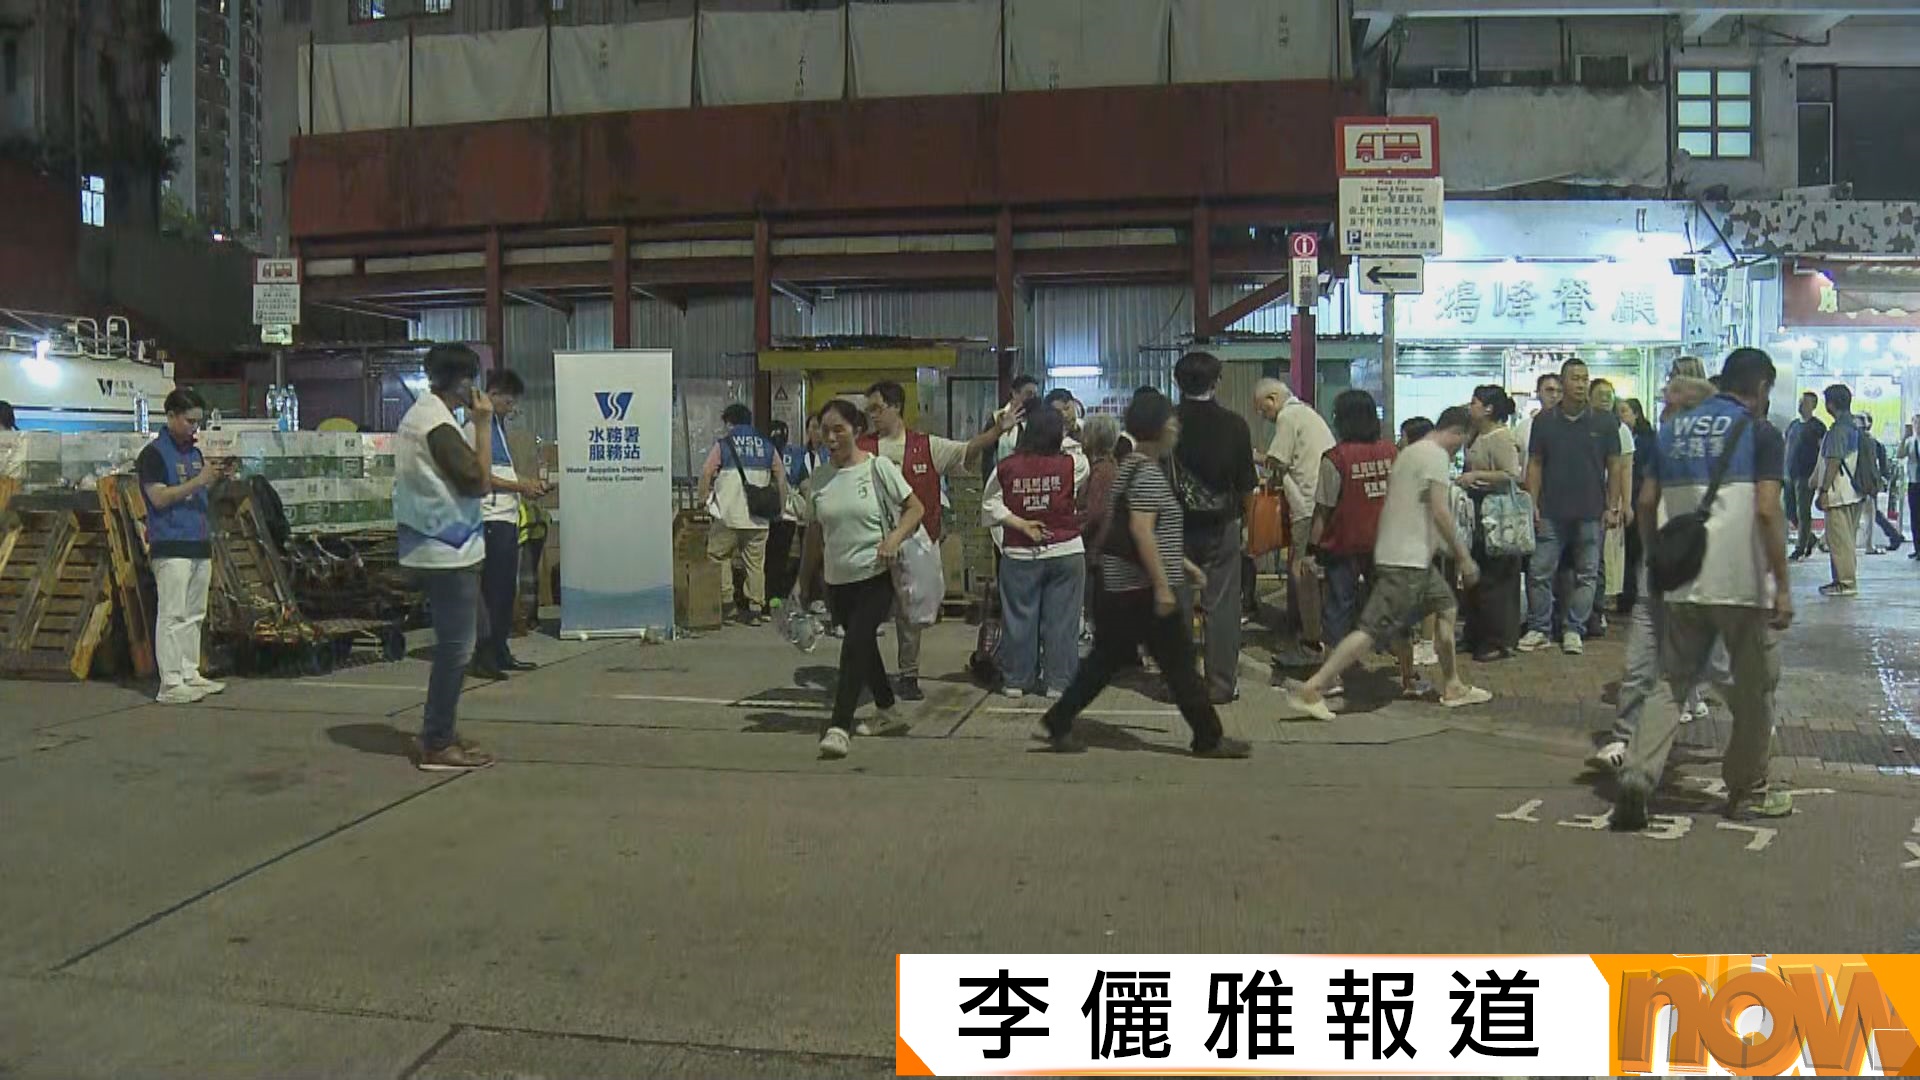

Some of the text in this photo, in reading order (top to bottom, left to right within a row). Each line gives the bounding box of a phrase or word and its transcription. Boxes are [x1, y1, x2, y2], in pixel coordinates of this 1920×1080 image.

[1673, 415, 1732, 435] WSD
[588, 426, 640, 443] 水務署
[733, 436, 763, 447] WSD
[589, 444, 640, 461] 服務站
[589, 466, 619, 474] Supplies
[622, 466, 663, 474] Department
